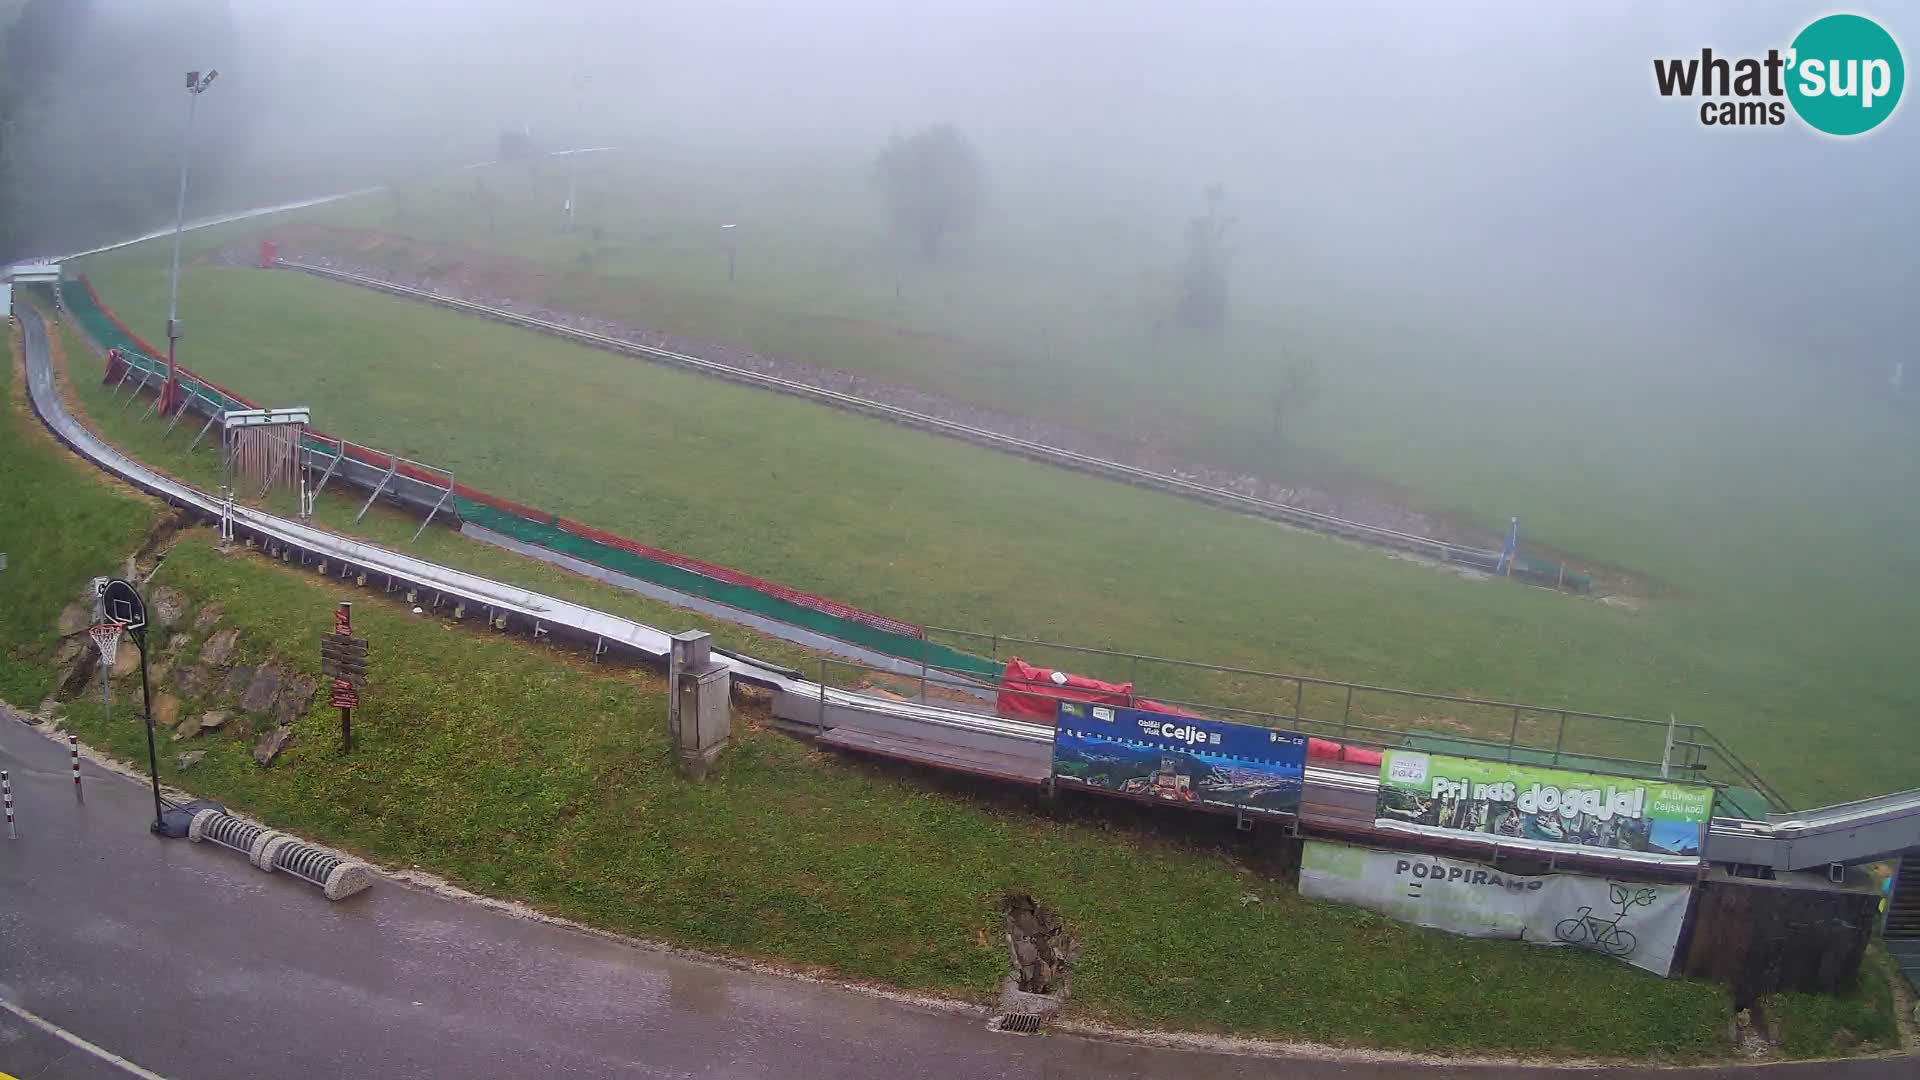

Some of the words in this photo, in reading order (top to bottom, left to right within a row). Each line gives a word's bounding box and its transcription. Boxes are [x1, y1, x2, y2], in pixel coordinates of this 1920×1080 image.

[1161, 723, 1207, 745] Celje
[1431, 776, 1469, 800] Pri
[1473, 782, 1516, 802] nas
[1395, 859, 1544, 892] PODPIRAMO
